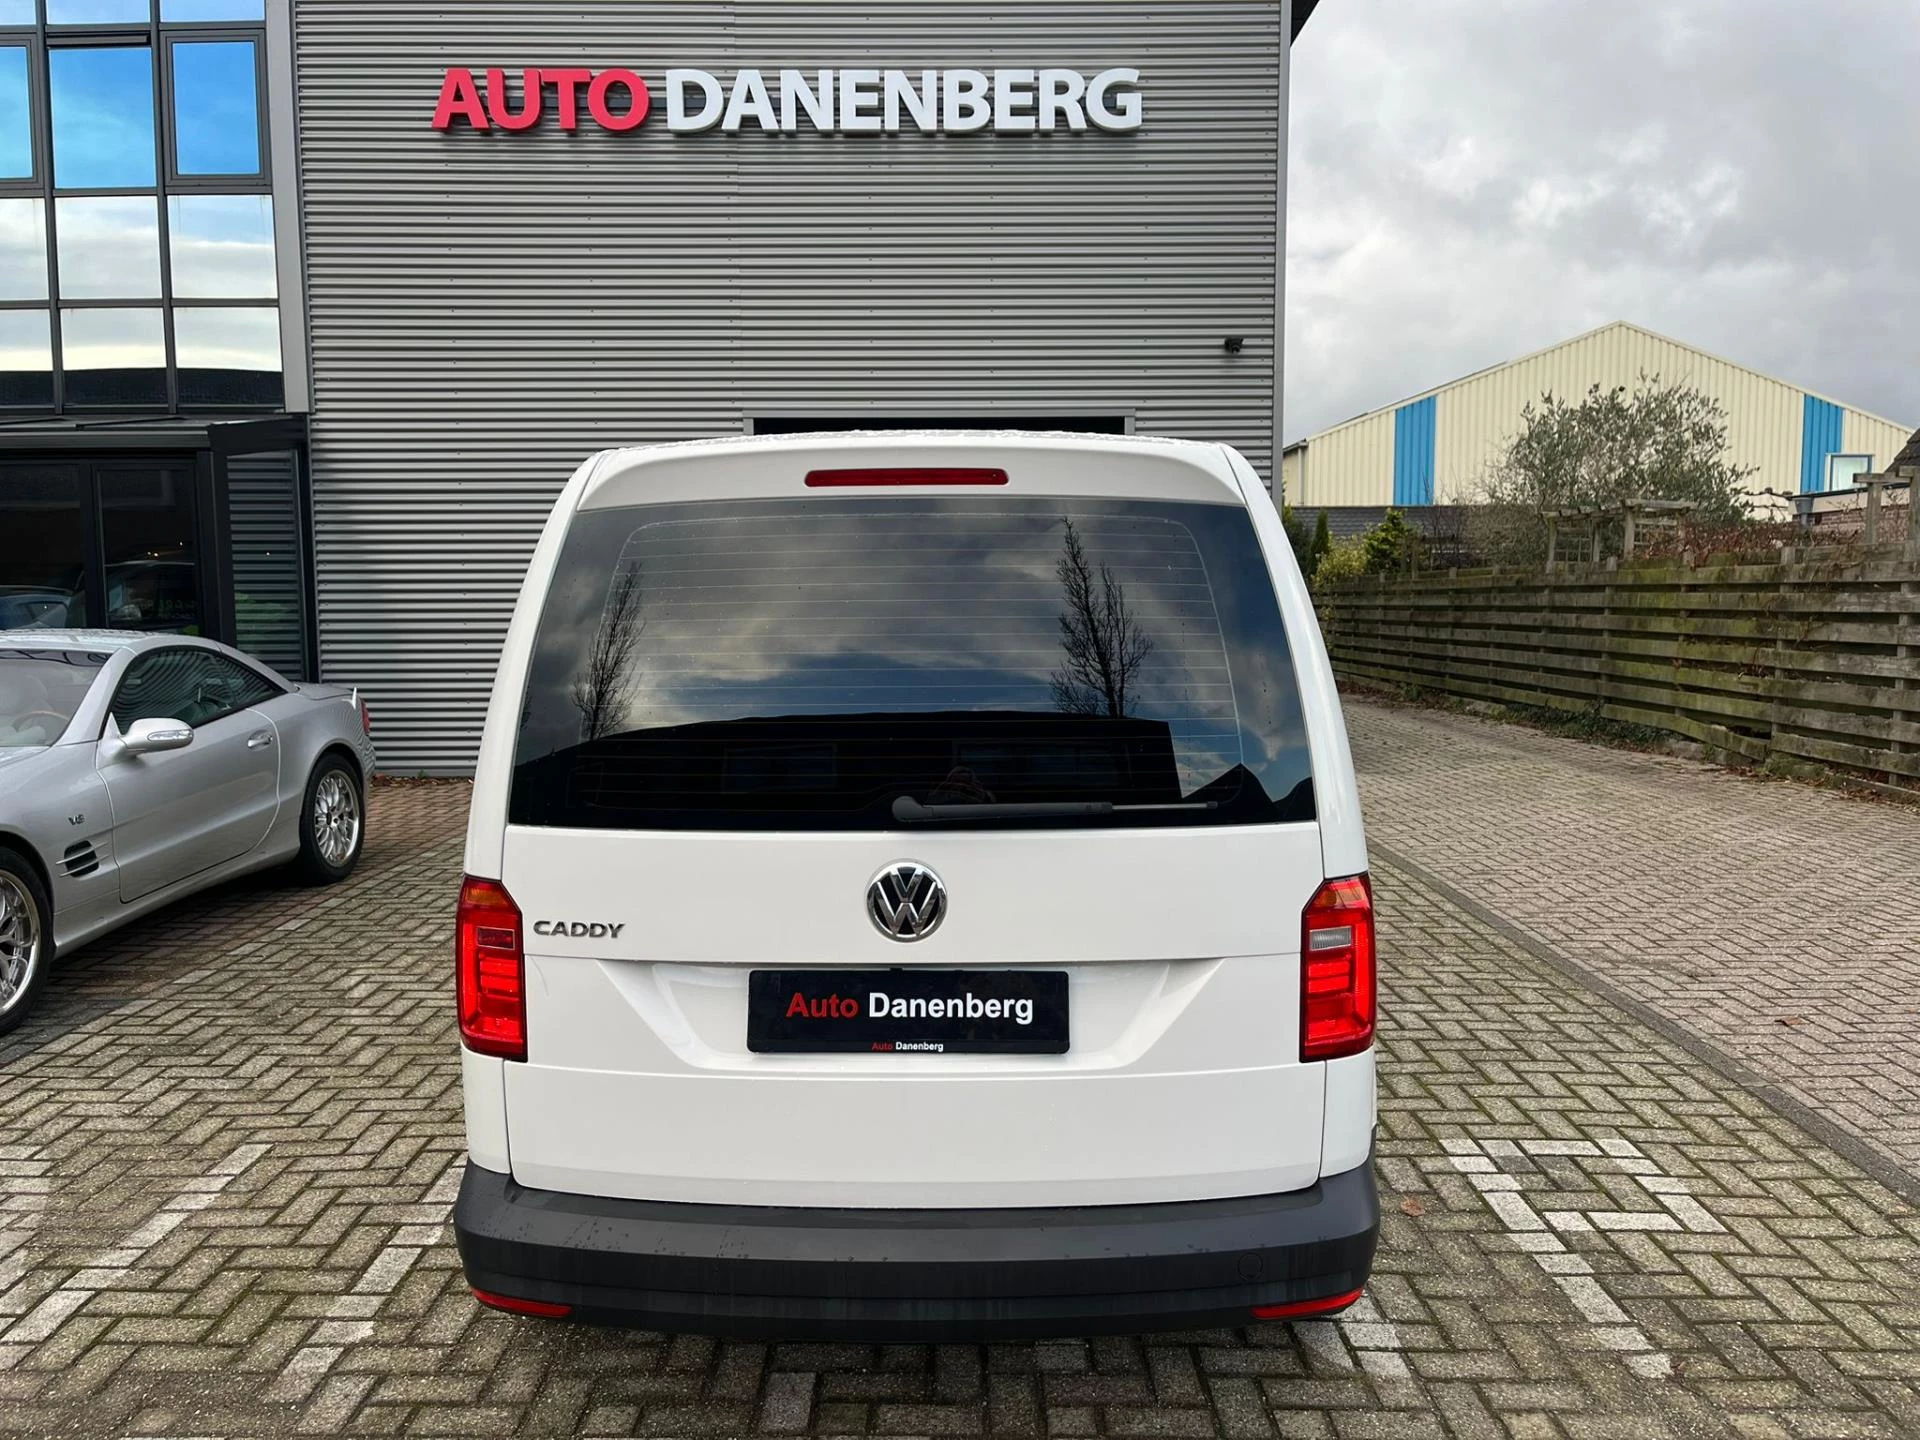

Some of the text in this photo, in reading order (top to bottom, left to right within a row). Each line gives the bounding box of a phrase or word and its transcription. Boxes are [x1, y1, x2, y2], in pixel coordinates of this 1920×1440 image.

[431, 68, 1143, 133] AUTO DANENBERG
[533, 920, 625, 938] CADDY
[786, 992, 1033, 1025] Auto Danenberg
[871, 1041, 944, 1053] Auto Danenberg
